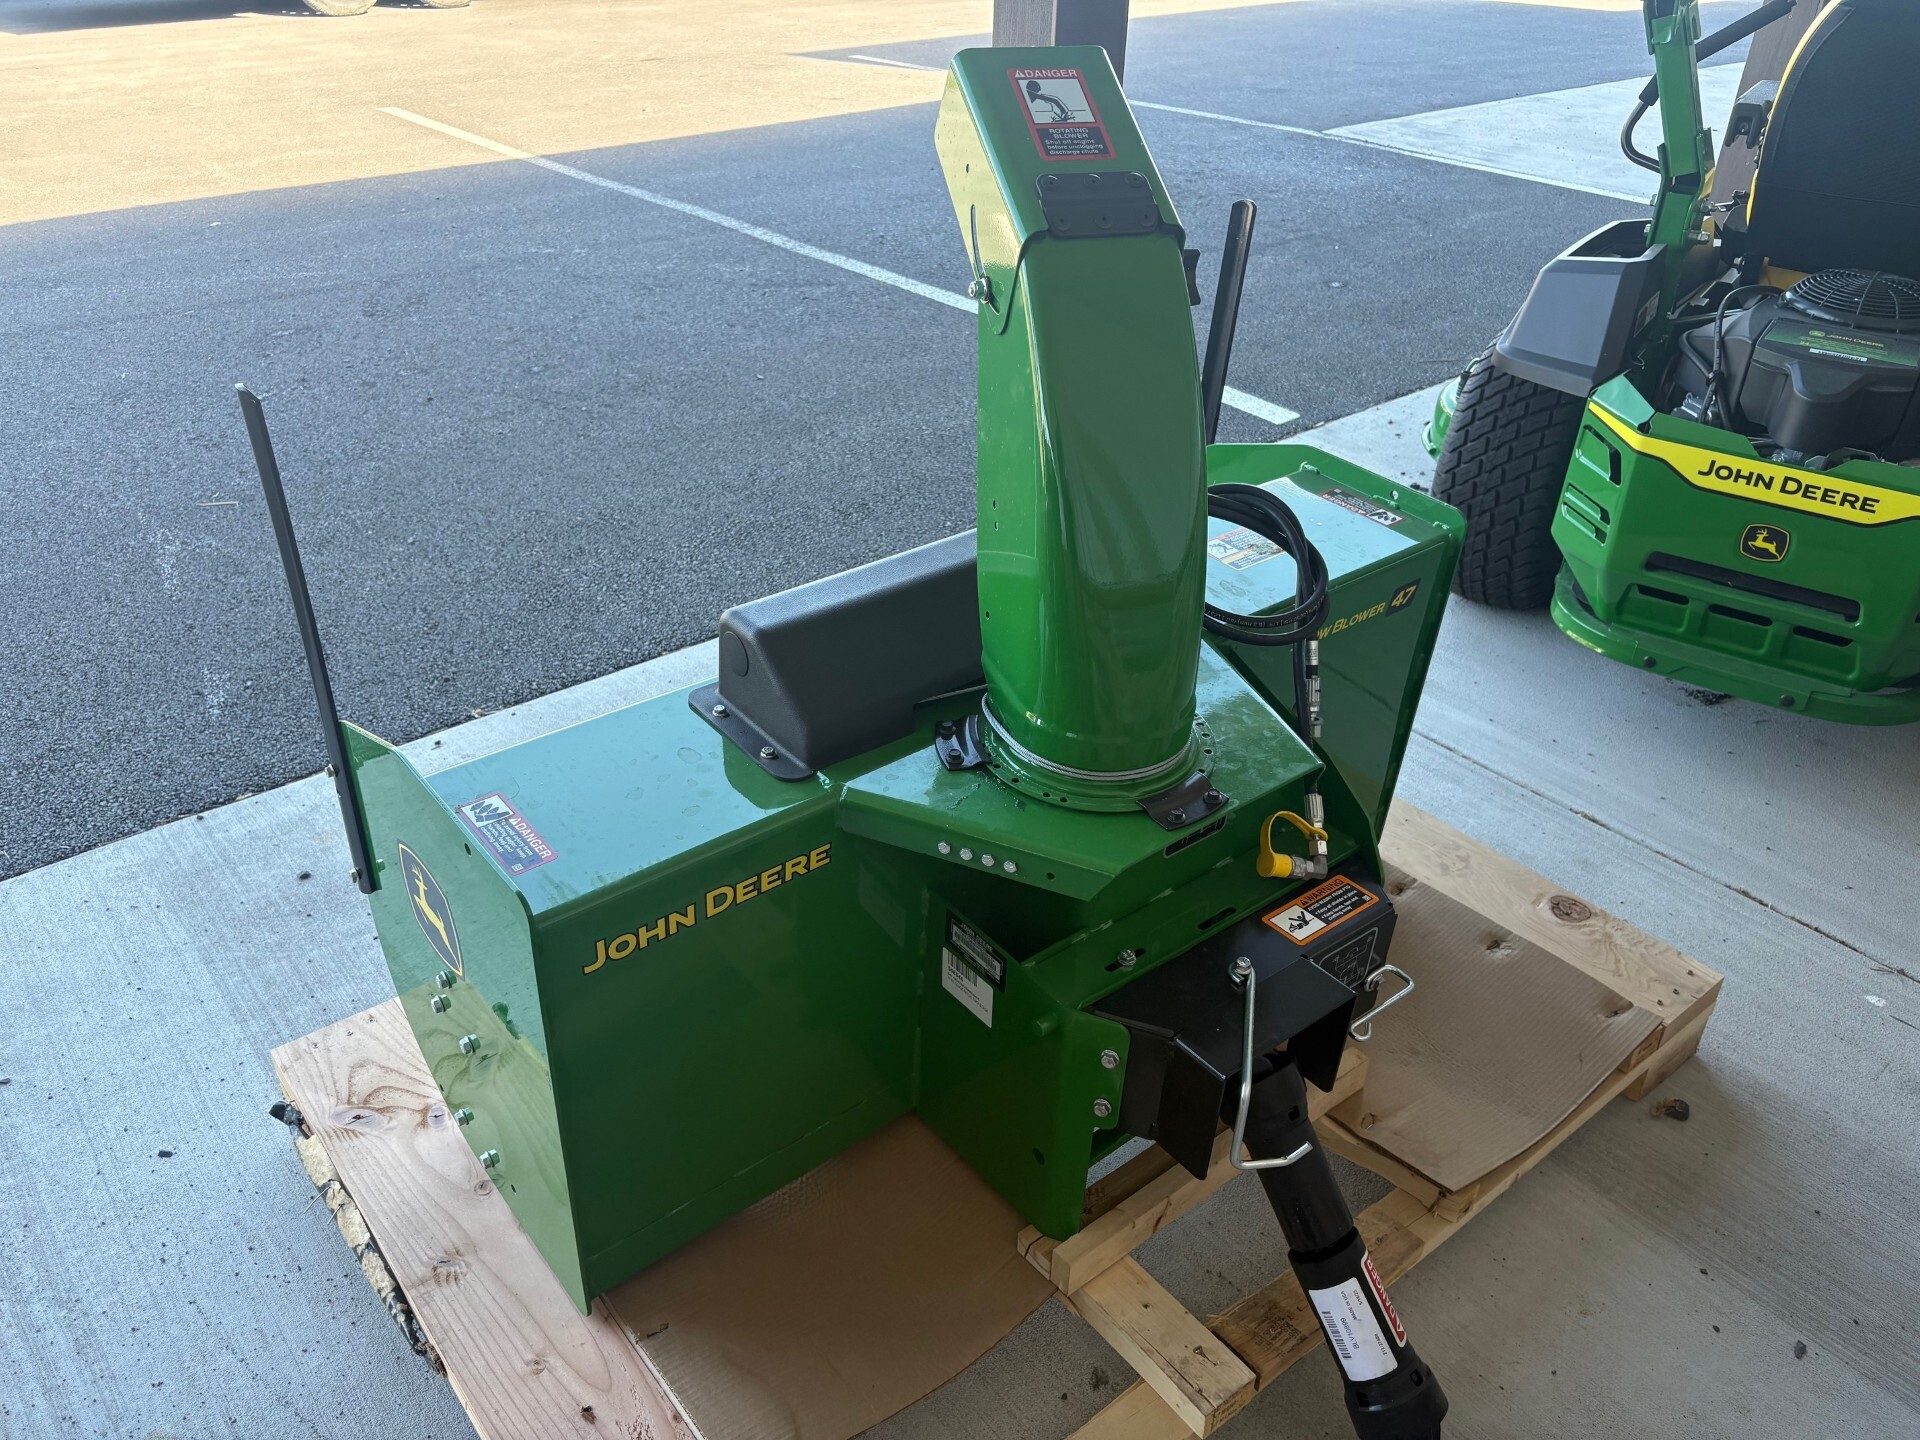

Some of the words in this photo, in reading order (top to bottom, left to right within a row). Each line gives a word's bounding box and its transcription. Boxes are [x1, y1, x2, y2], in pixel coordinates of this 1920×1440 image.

[1826, 333, 1852, 343] JOHN
[1854, 338, 1884, 347] DEERE
[1698, 460, 1775, 490] JOHN
[1779, 476, 1880, 514] DEERE
[1322, 493, 1360, 513] DANGER
[1332, 602, 1385, 635] BLOWER
[1391, 585, 1417, 608] 47
[480, 826, 494, 841] clothing
[504, 824, 514, 834] avoid
[511, 835, 524, 846] injury
[522, 846, 533, 855] from
[514, 822, 552, 859] DANGER
[515, 848, 526, 858] keep
[1305, 878, 1344, 902] WARNING
[1319, 895, 1332, 903] INJURY
[582, 902, 696, 976] JOHN
[704, 842, 832, 919] DEERE
[1328, 911, 1343, 920] clothing
[1366, 1258, 1398, 1318] DANGER
[1347, 1306, 1358, 1320] MADE
